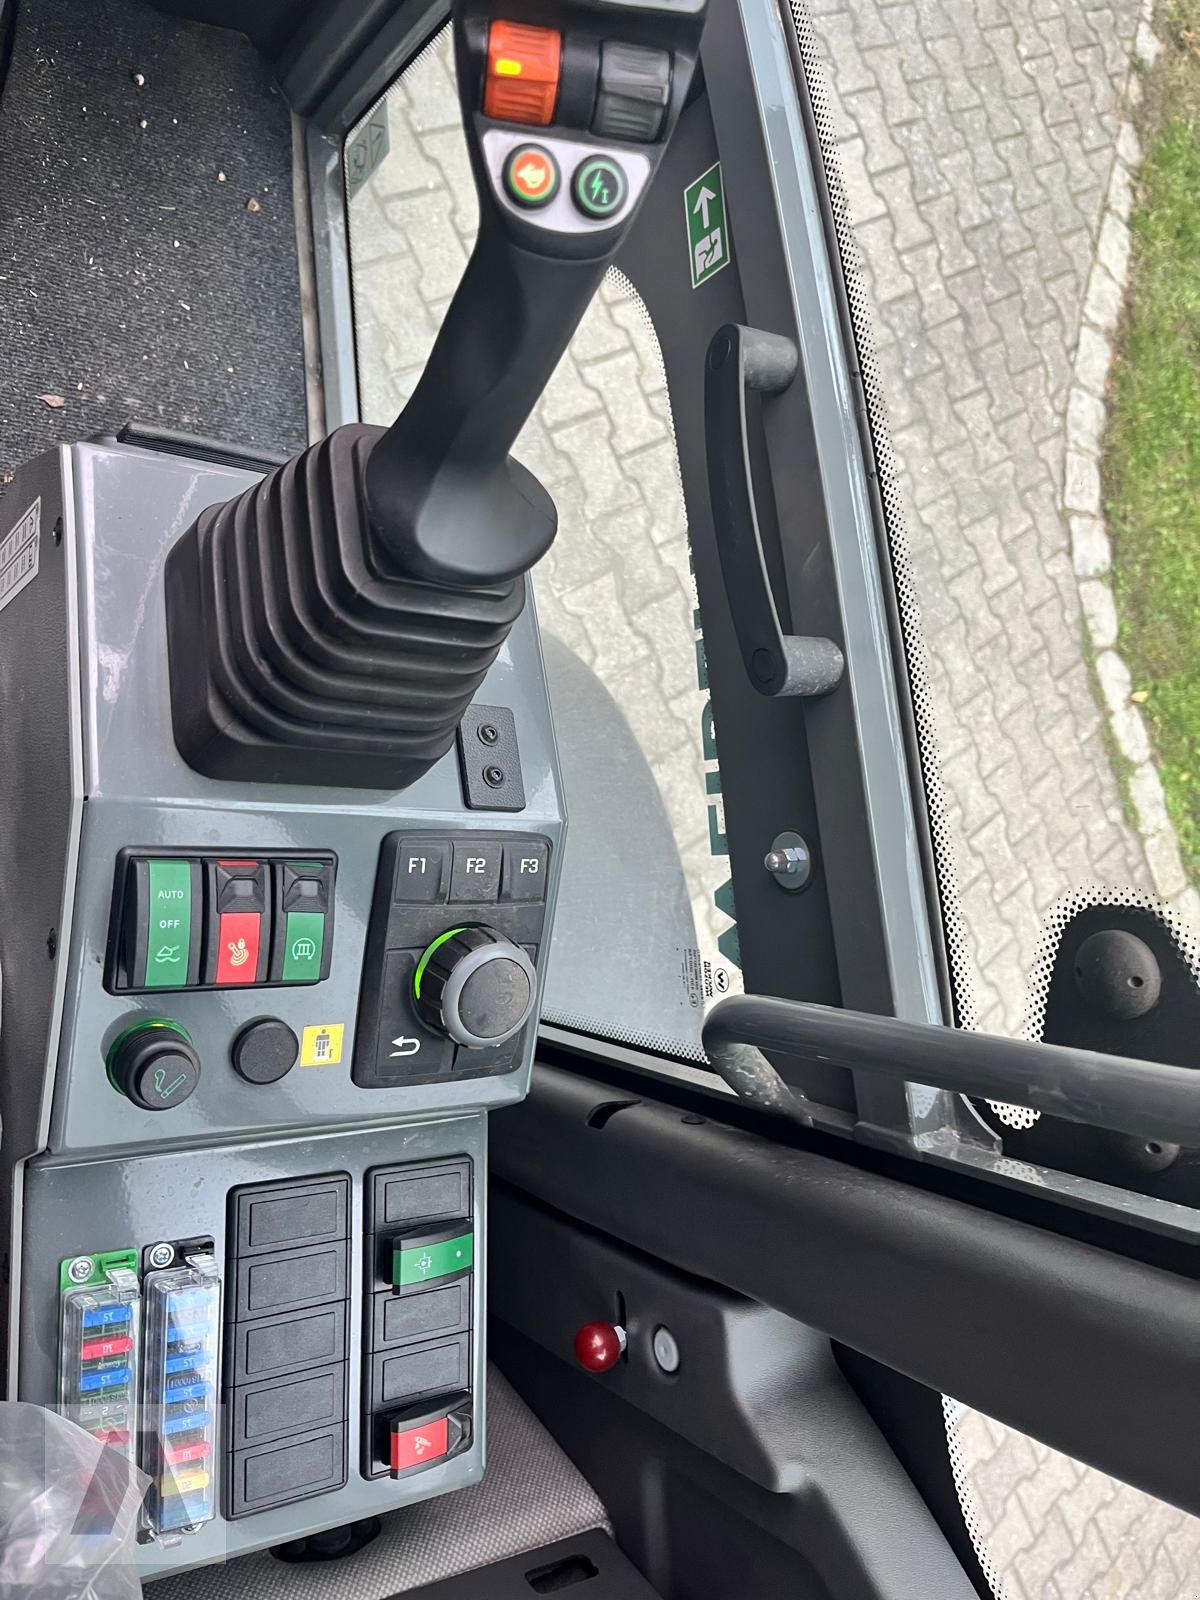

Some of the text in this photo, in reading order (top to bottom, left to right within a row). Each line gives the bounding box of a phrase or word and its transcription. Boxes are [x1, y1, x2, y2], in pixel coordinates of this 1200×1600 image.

[408, 857, 427, 874] F1
[466, 857, 486, 874] F2
[520, 858, 539, 874] F3
[157, 889, 185, 900] AUTO
[159, 919, 181, 929] OFF
